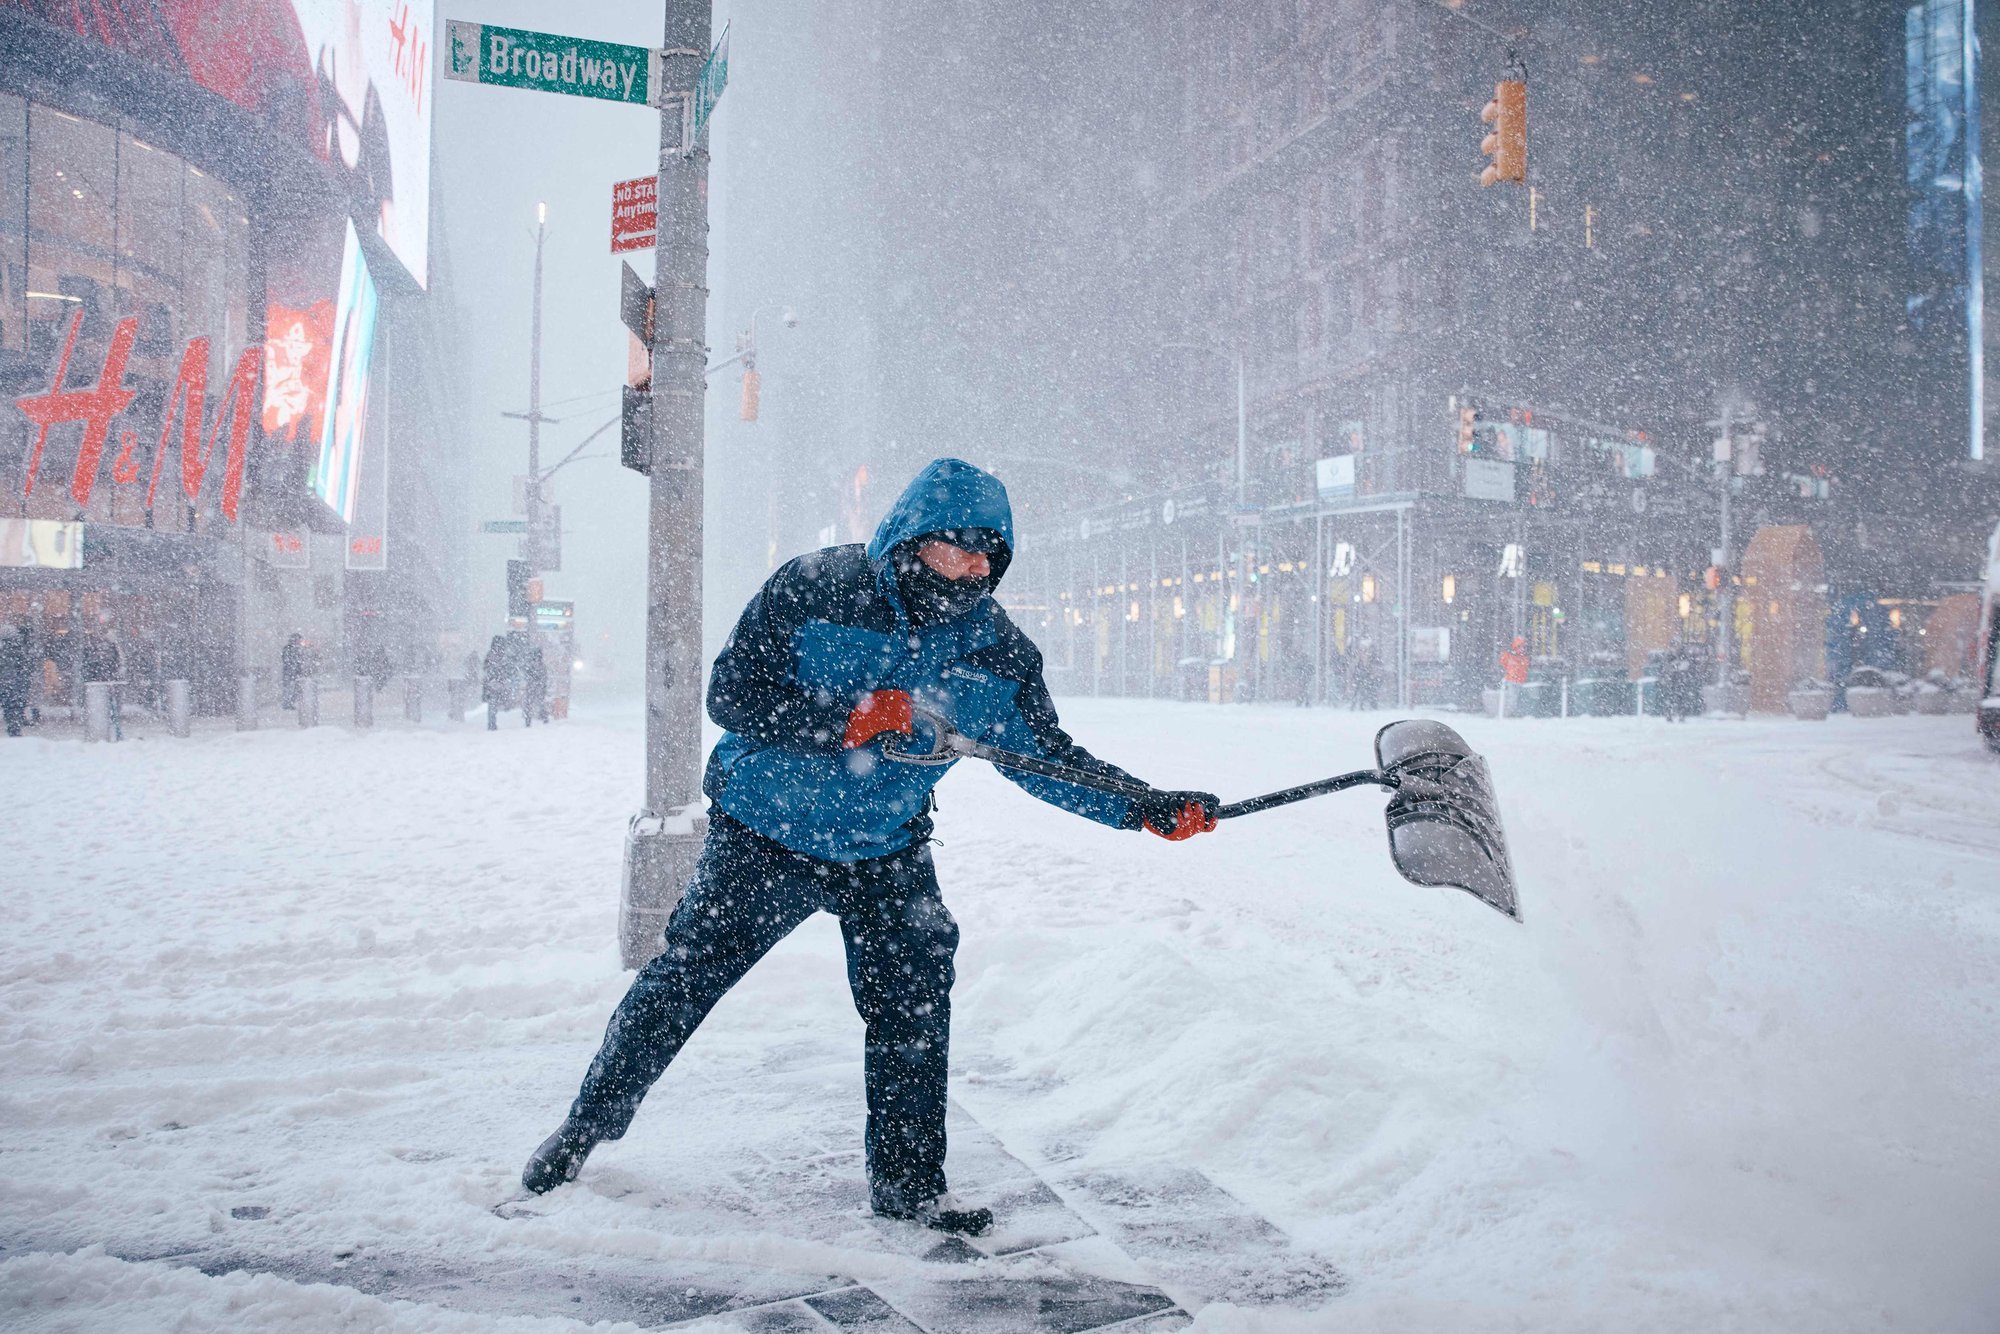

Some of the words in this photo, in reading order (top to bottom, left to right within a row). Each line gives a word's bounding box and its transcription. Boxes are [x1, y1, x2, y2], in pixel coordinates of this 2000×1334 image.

[490, 35, 637, 100] Broadway
[617, 188, 631, 202] NO
[16, 307, 262, 524] H&M
